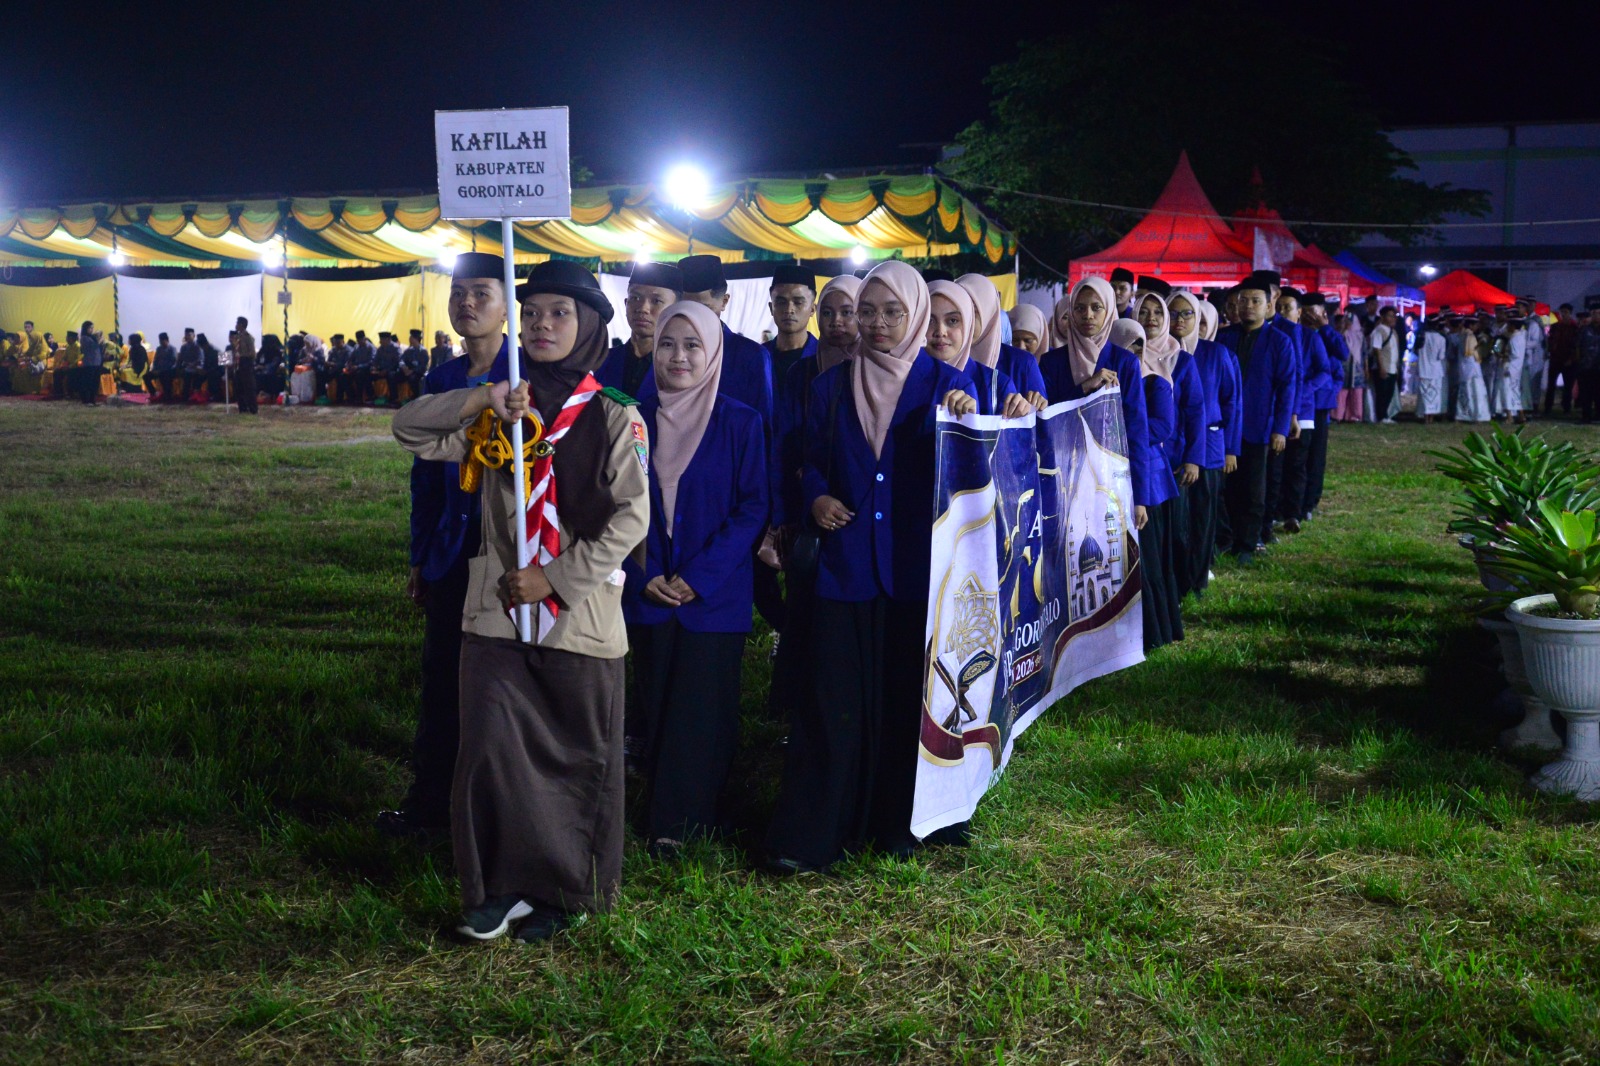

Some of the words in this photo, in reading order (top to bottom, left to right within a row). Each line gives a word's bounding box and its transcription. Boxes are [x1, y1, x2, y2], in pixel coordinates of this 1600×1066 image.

[450, 131, 547, 151] KAFILAH
[455, 161, 545, 175] KABUPATEN
[457, 184, 544, 198] GORONTALO
